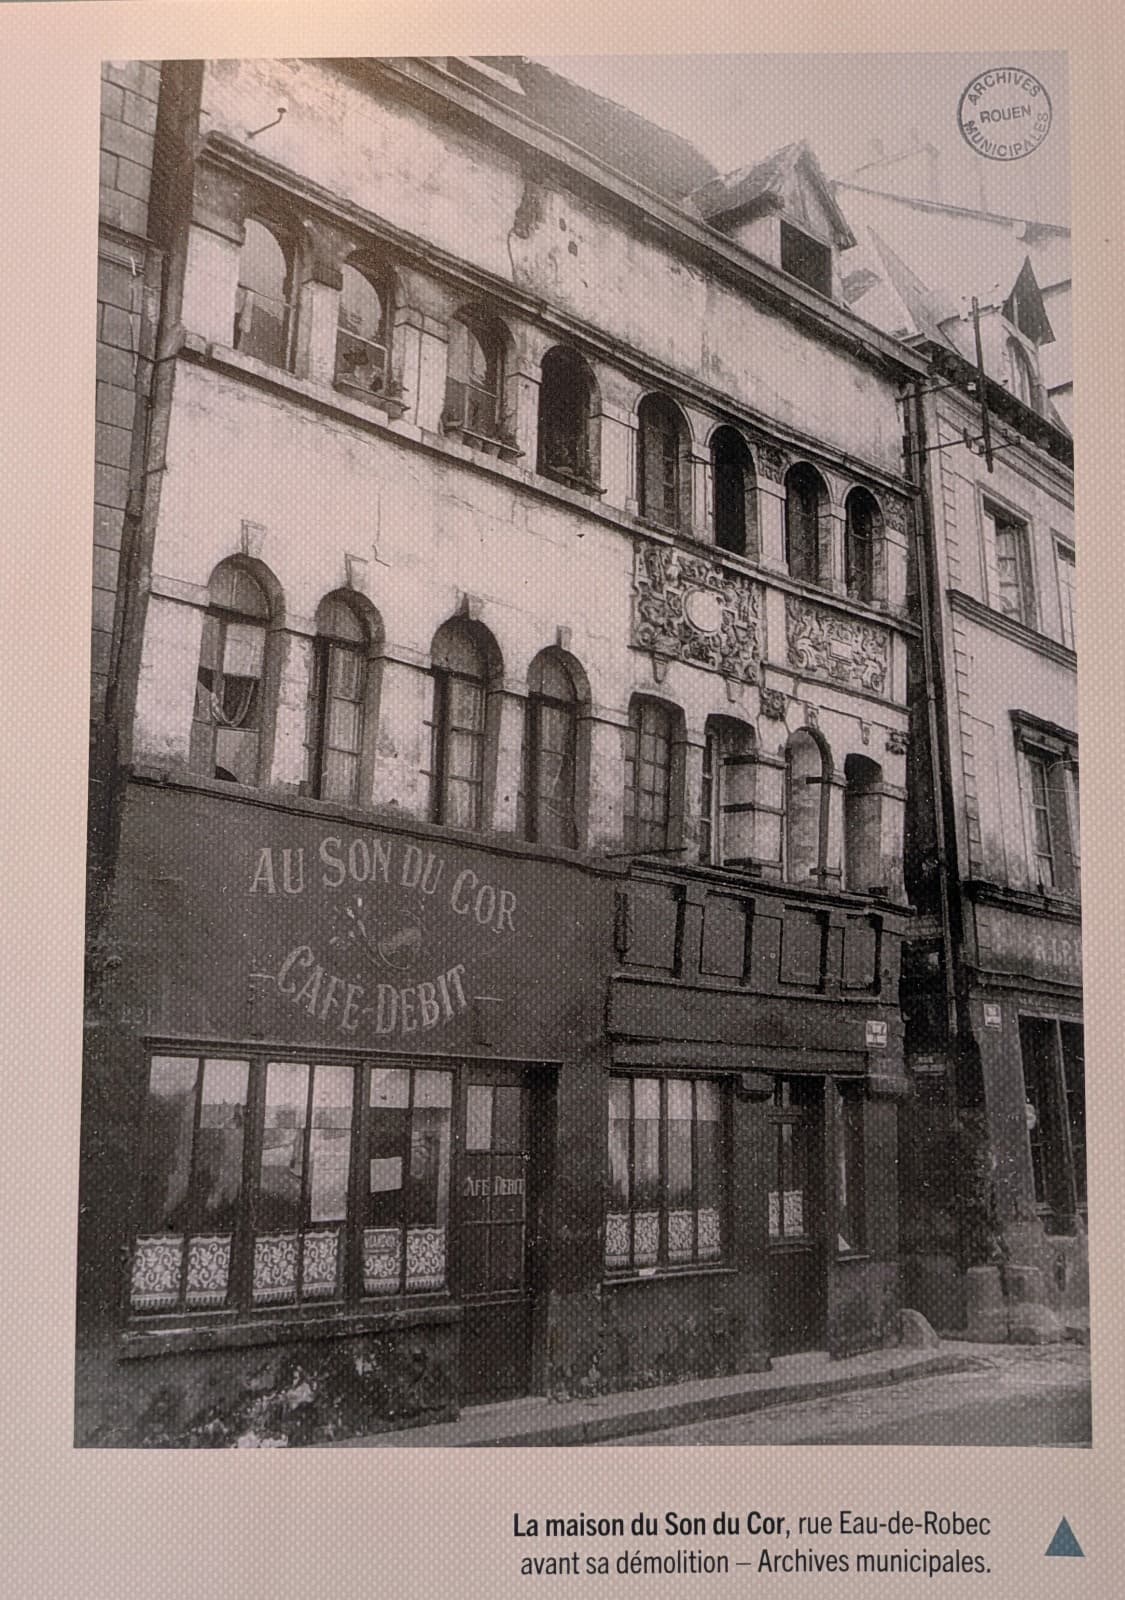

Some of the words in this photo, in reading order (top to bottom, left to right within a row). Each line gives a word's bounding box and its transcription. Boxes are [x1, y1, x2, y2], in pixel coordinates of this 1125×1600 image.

[250, 847, 304, 894] AU
[319, 836, 392, 888] SON
[400, 844, 445, 895] DU
[451, 869, 517, 934] COR
[514, 1512, 538, 1537] La
[546, 1512, 624, 1537] maison
[631, 1512, 658, 1536] du
[665, 1511, 706, 1536] Son
[713, 1511, 740, 1535] du
[747, 1511, 791, 1539] Cor,
[799, 1515, 832, 1535] rue
[840, 1510, 991, 1536] Eau-de-Robec
[521, 1552, 580, 1575] avant
[586, 1556, 609, 1574] sa
[616, 1549, 729, 1574] démolition
[758, 1548, 850, 1573] Archives
[856, 1548, 991, 1578] municipales.
